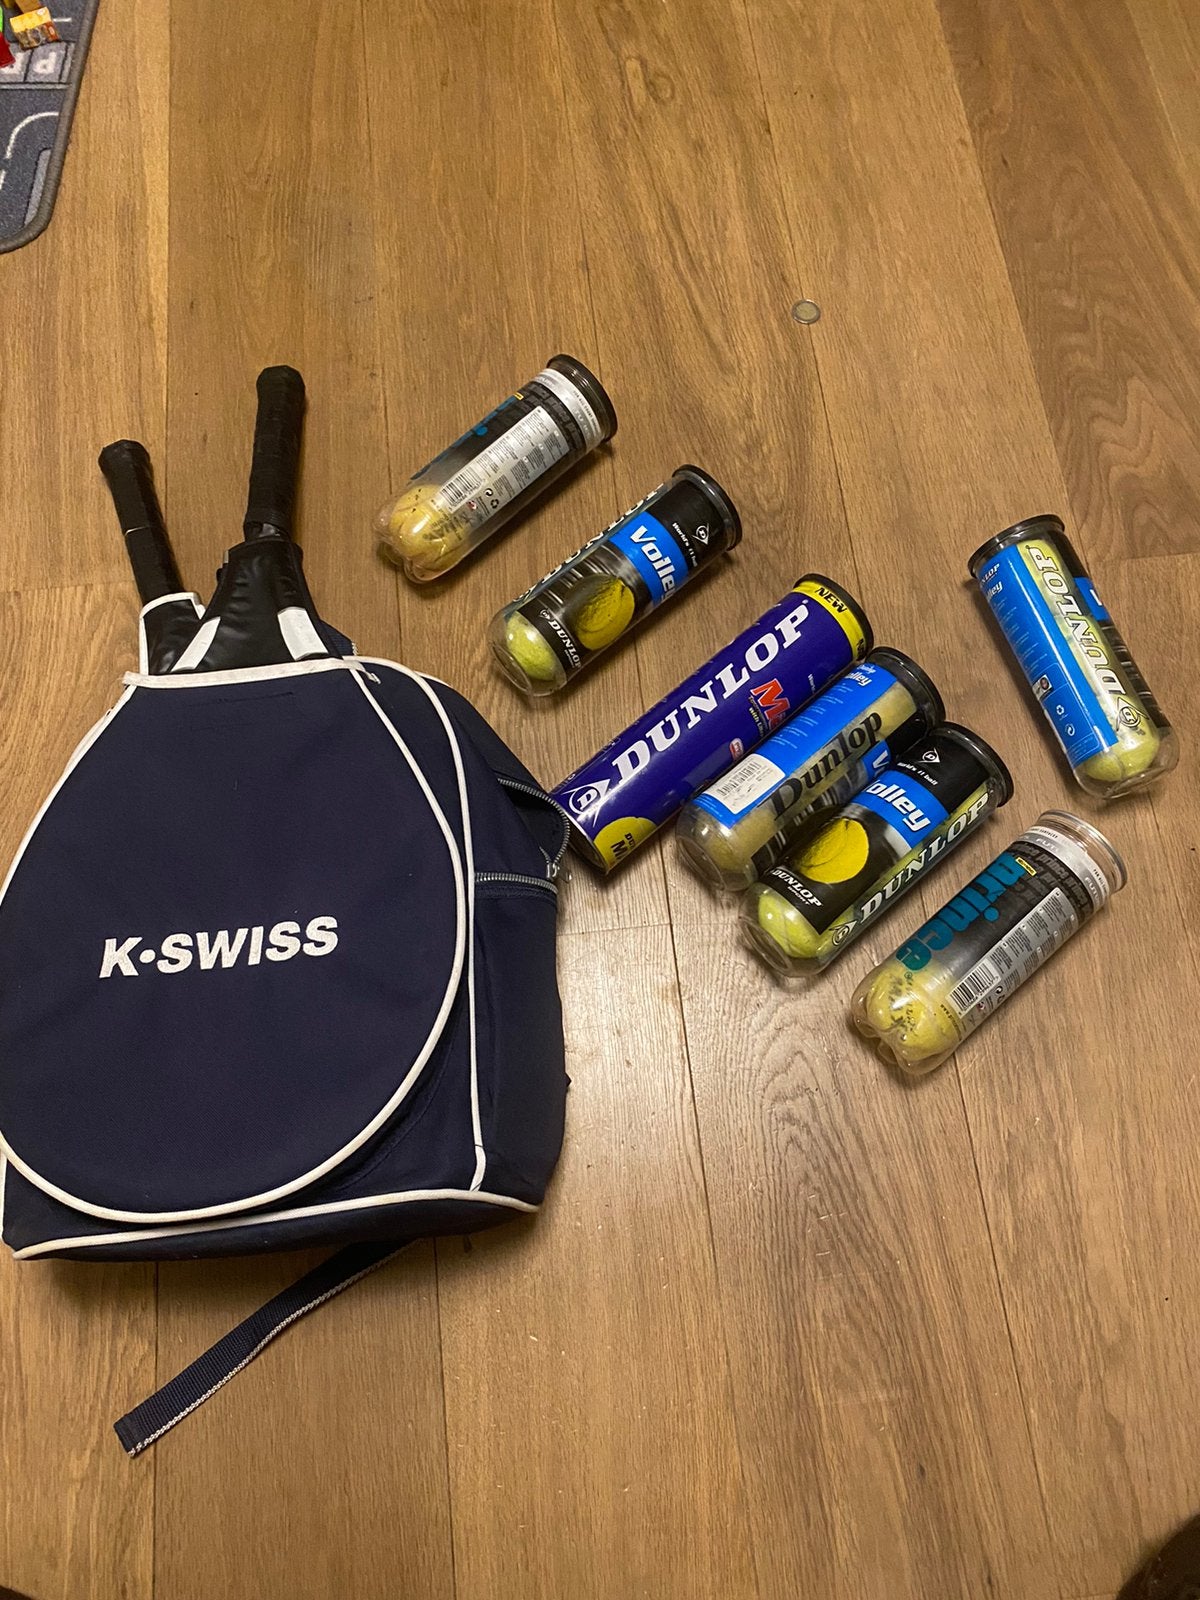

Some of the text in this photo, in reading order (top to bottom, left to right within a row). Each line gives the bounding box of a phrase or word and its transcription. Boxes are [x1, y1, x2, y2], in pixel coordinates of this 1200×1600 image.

[548, 620, 582, 669] DUNLOP
[815, 586, 849, 615] NEW
[1027, 544, 1127, 697] DUNLOP
[611, 602, 810, 782] DUNLOP
[768, 711, 883, 822] Dunlop
[771, 868, 824, 909] DUNLOP
[859, 791, 991, 924] DUNLOP
[895, 852, 1027, 971] prince
